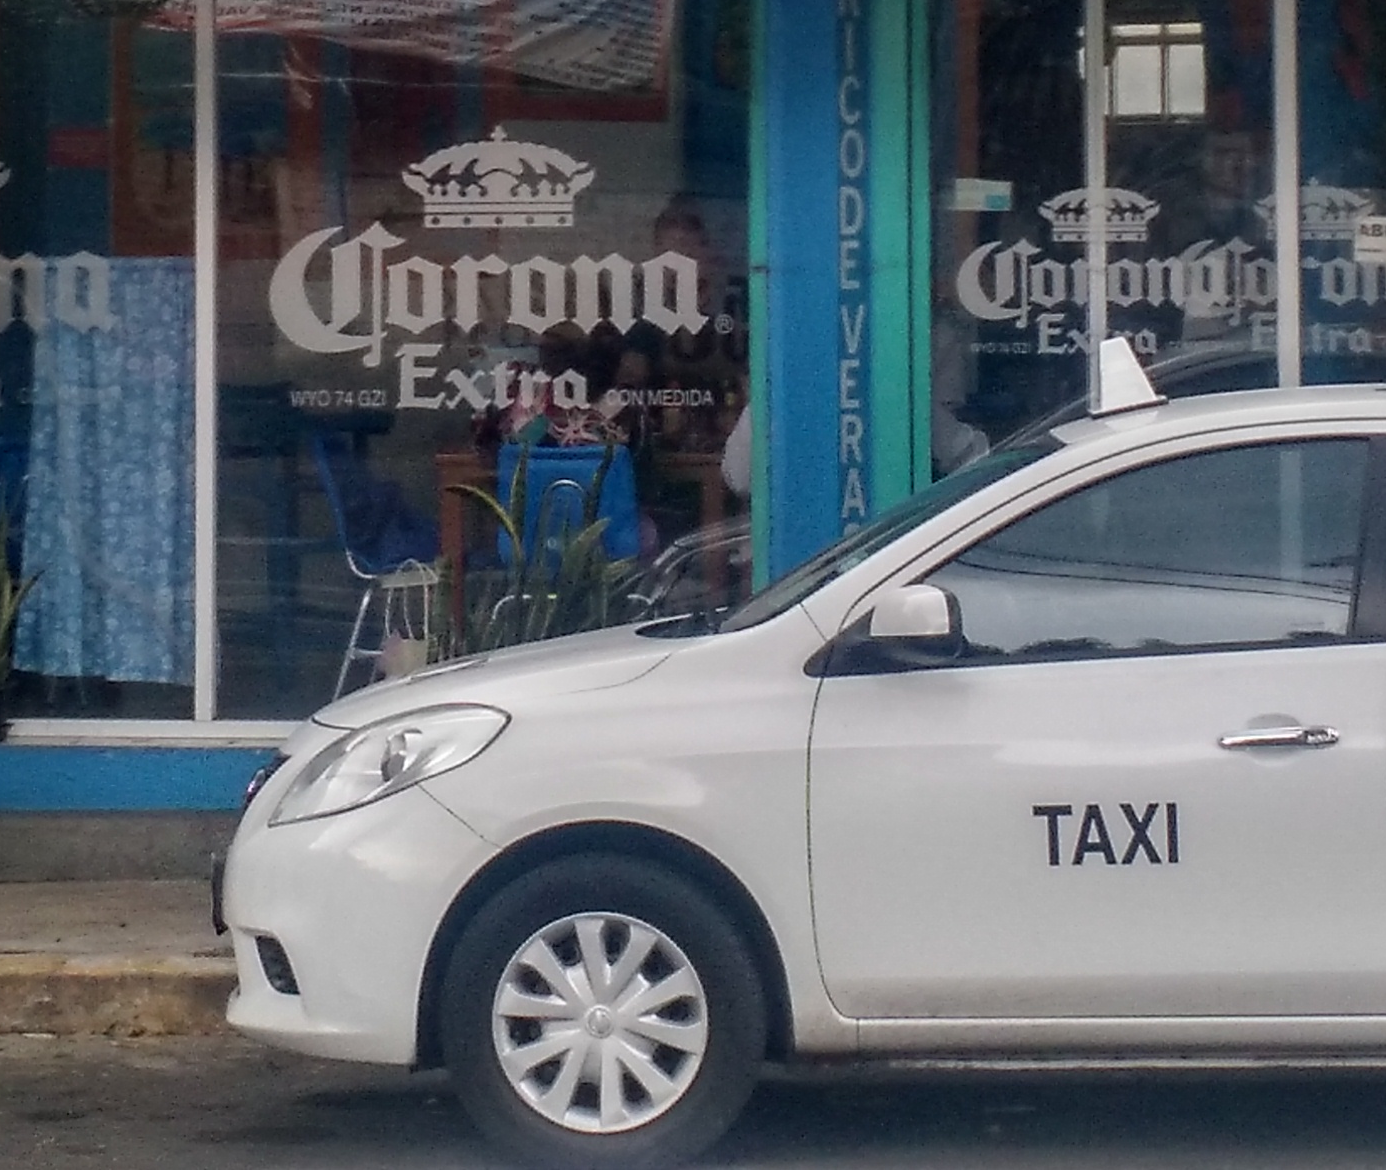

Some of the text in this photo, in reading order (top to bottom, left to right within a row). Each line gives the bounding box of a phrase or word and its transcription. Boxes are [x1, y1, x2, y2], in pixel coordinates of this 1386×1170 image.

[269, 221, 710, 368] Corona
[334, 389, 355, 408] 74
[396, 343, 591, 410] Extra
[605, 388, 713, 407] CON MEDIDA
[1033, 802, 1180, 867] TAXI
